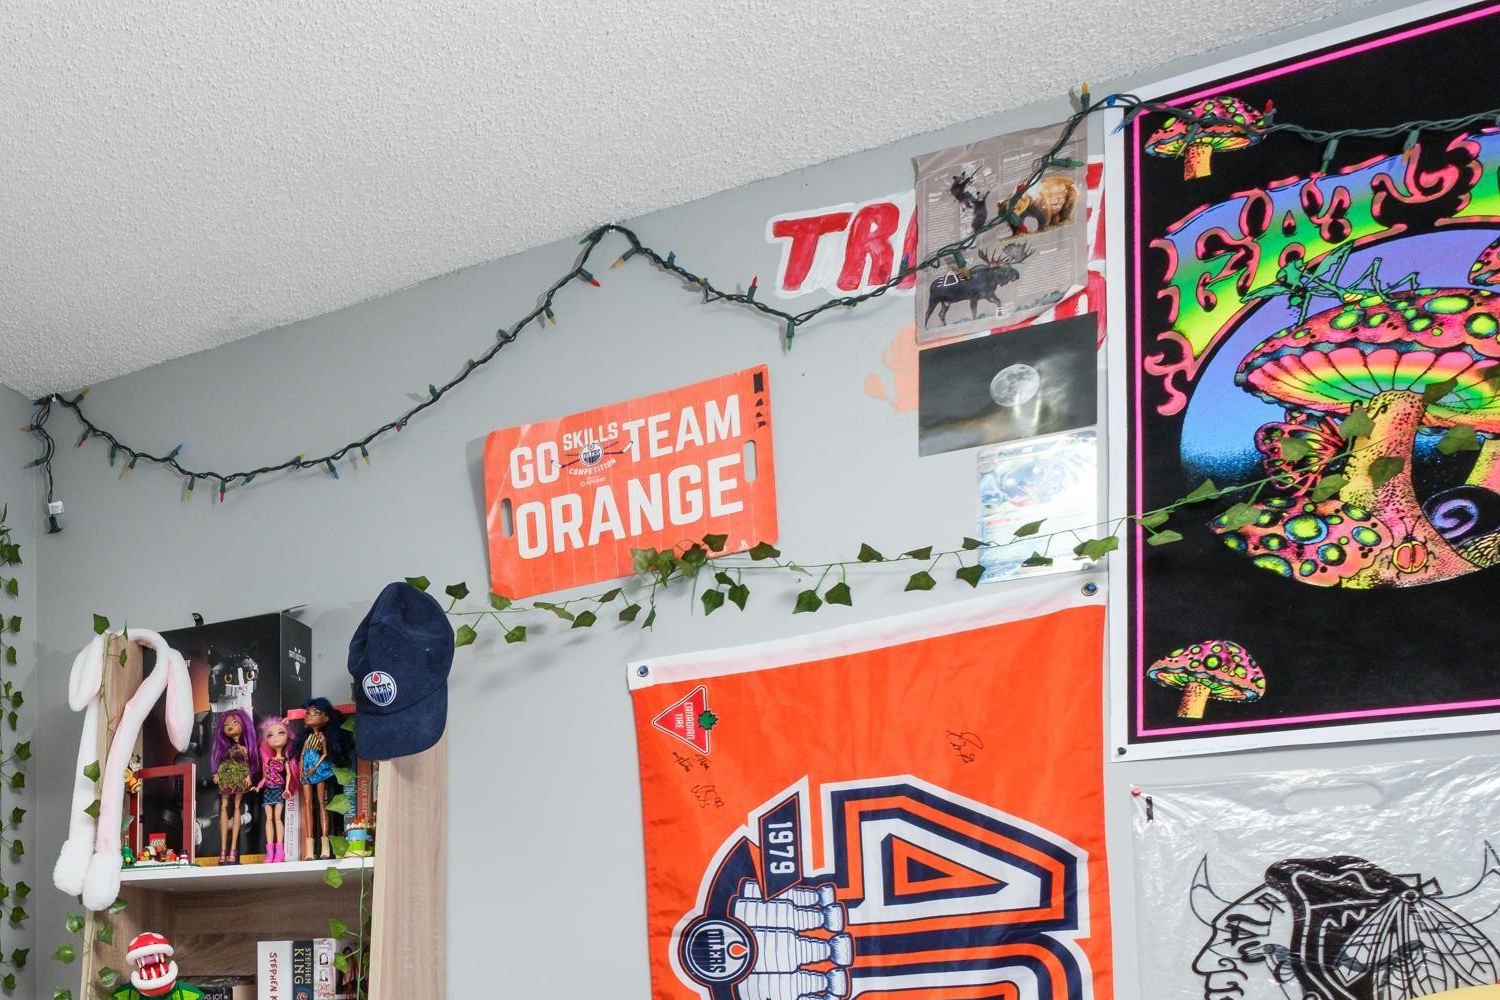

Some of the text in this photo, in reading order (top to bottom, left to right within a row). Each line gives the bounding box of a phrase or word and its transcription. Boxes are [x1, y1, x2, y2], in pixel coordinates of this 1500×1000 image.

[509, 393, 742, 490] GO TEAM
[562, 421, 619, 451] SKILLS
[568, 457, 617, 475] COMPETITION
[515, 453, 744, 560] ORANGE
[150, 839, 165, 848] LEGO
[767, 821, 795, 875] 1979
[294, 948, 304, 985] KING
[701, 928, 727, 974] OILERS
[269, 952, 278, 992] STEPHEN
